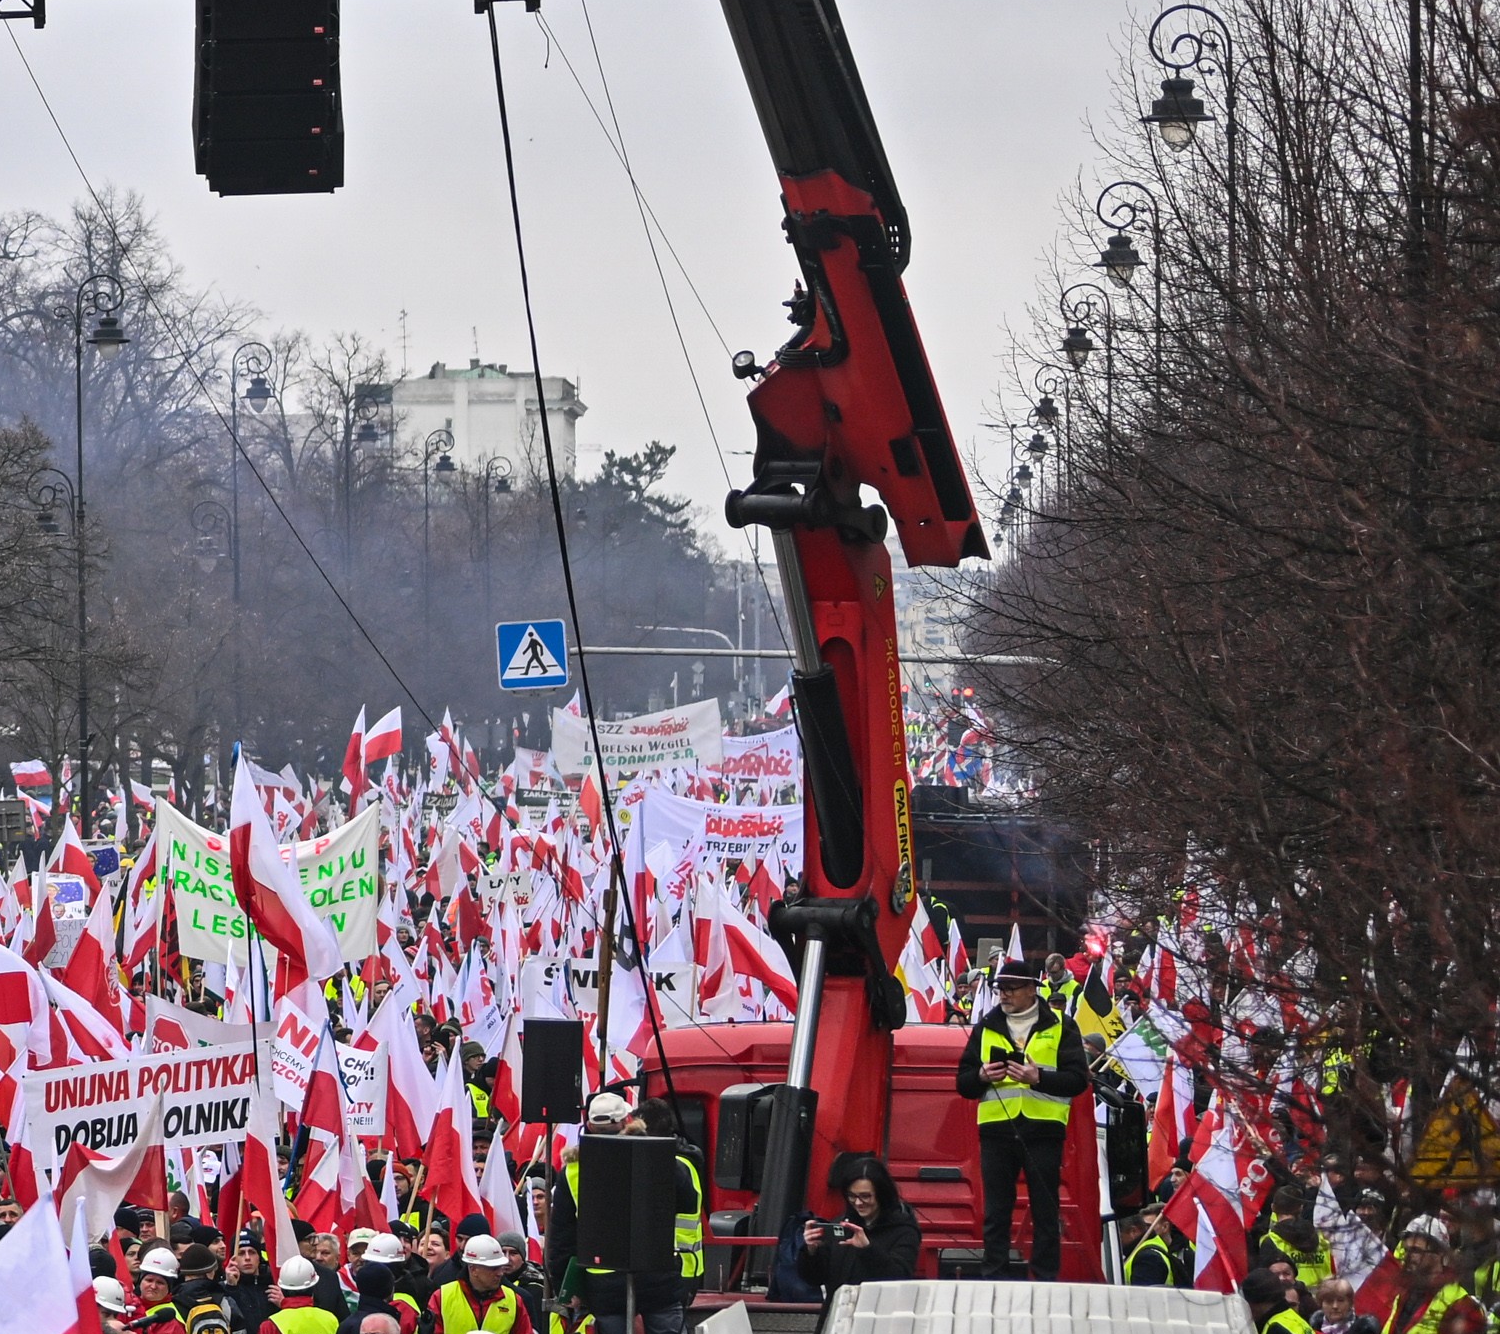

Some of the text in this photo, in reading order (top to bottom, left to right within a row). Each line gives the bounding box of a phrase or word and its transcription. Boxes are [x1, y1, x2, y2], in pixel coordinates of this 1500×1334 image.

[584, 741, 643, 754] LBELSKI
[895, 786, 912, 896] PALFINGR
[45, 1051, 255, 1114] UNIJNA POLITYKA
[55, 1096, 252, 1156] DOBIJA OLNIKA
